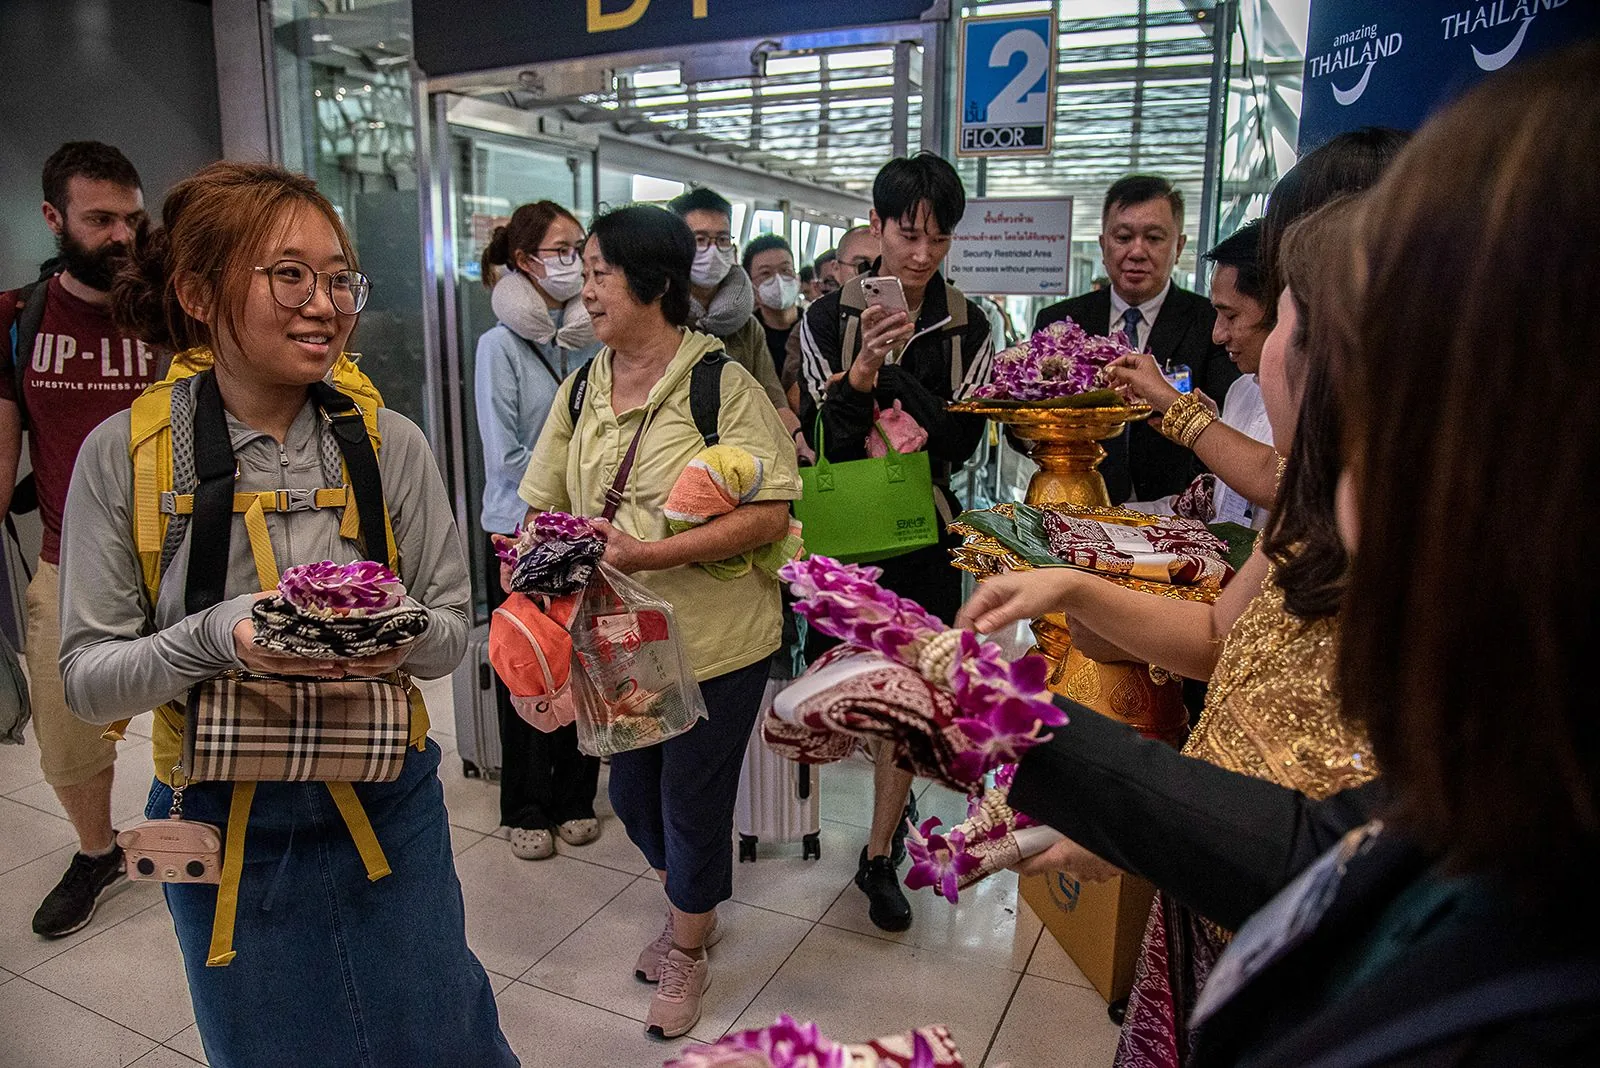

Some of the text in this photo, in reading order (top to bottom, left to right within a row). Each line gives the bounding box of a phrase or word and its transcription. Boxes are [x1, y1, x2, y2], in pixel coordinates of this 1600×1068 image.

[1440, 0, 1568, 40] THAILA
[1333, 23, 1377, 47] amazing
[1309, 32, 1403, 78] THAILAND
[988, 28, 1048, 123] 2
[964, 126, 1025, 148] FLOOR
[963, 249, 1052, 259] Security Restricted Area
[951, 265, 961, 273] Do
[1026, 266, 1064, 274] permission
[31, 380, 84, 390] LIFESTYLE
